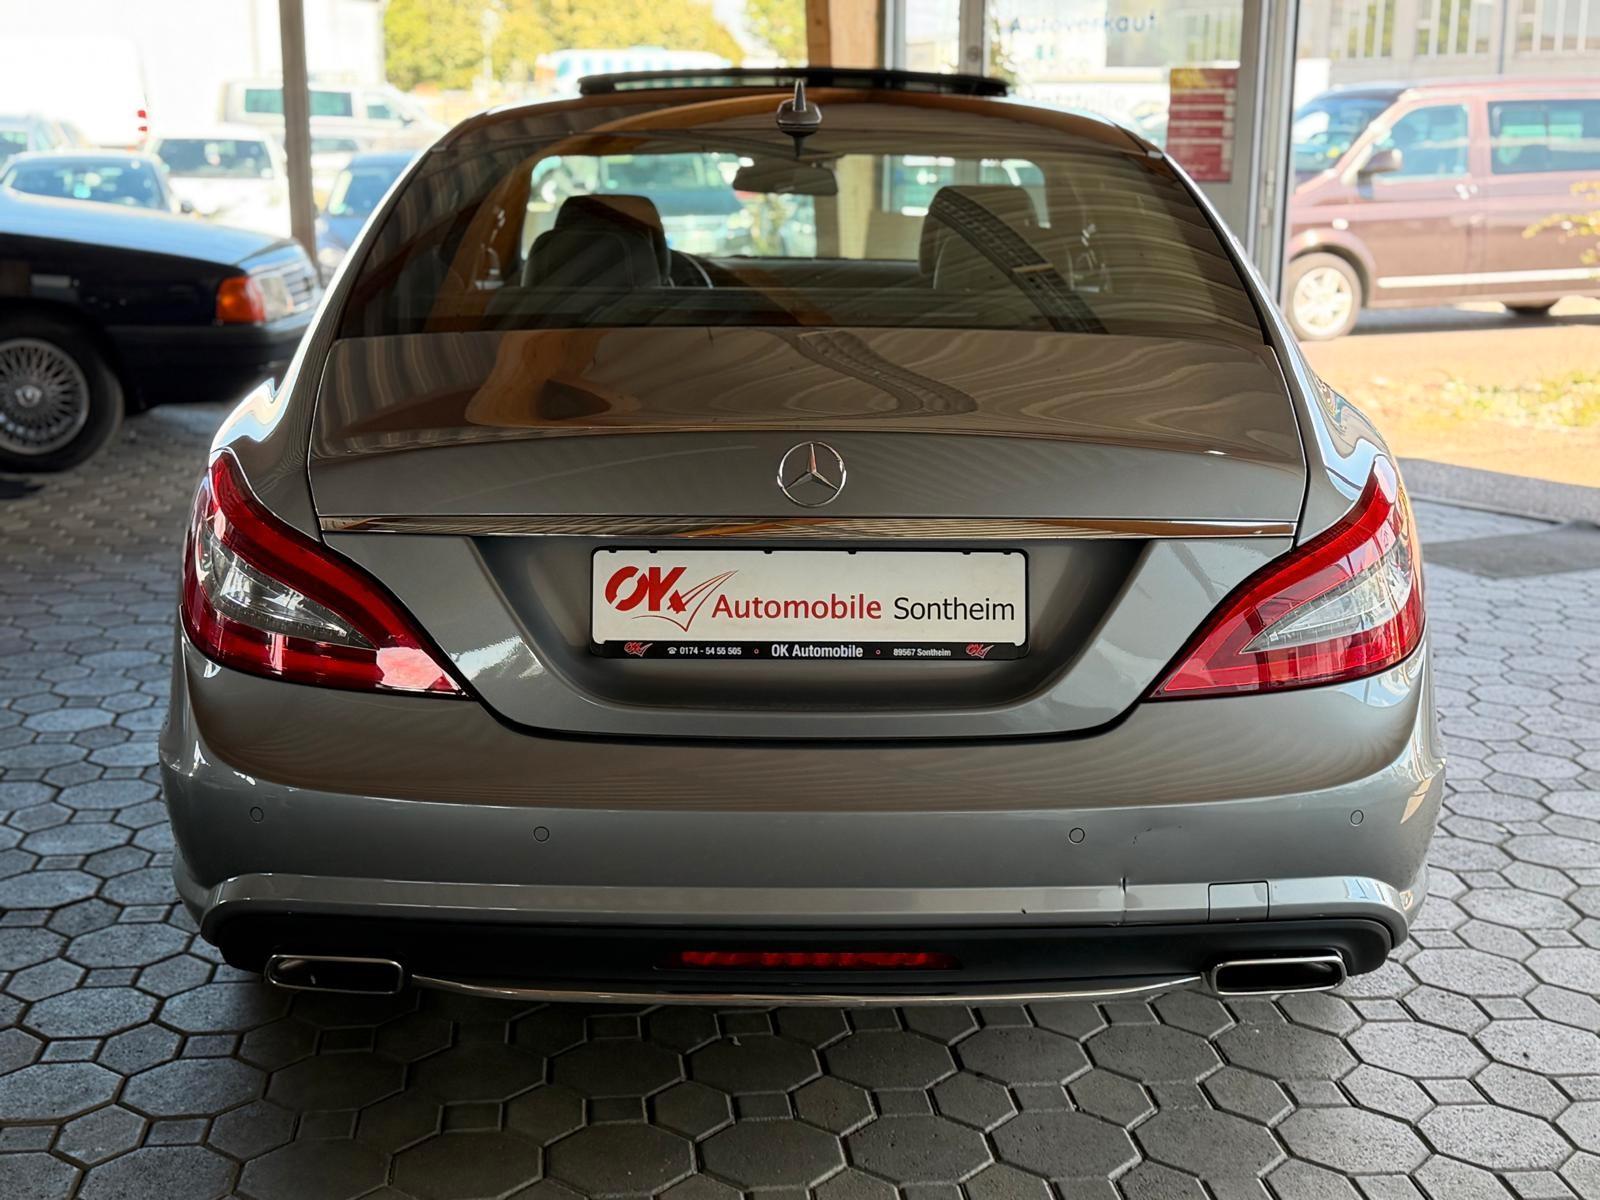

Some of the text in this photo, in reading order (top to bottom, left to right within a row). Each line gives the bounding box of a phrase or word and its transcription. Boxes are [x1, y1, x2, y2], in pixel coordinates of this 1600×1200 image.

[605, 565, 689, 614] OK
[712, 594, 1015, 621] Automobile Sontheim
[679, 646, 699, 655] 0174
[705, 646, 715, 655] 54
[716, 646, 727, 655] 55
[727, 646, 742, 655] 505
[771, 643, 864, 658] OK Automobile
[893, 648, 952, 658] 89567 Sontheim
